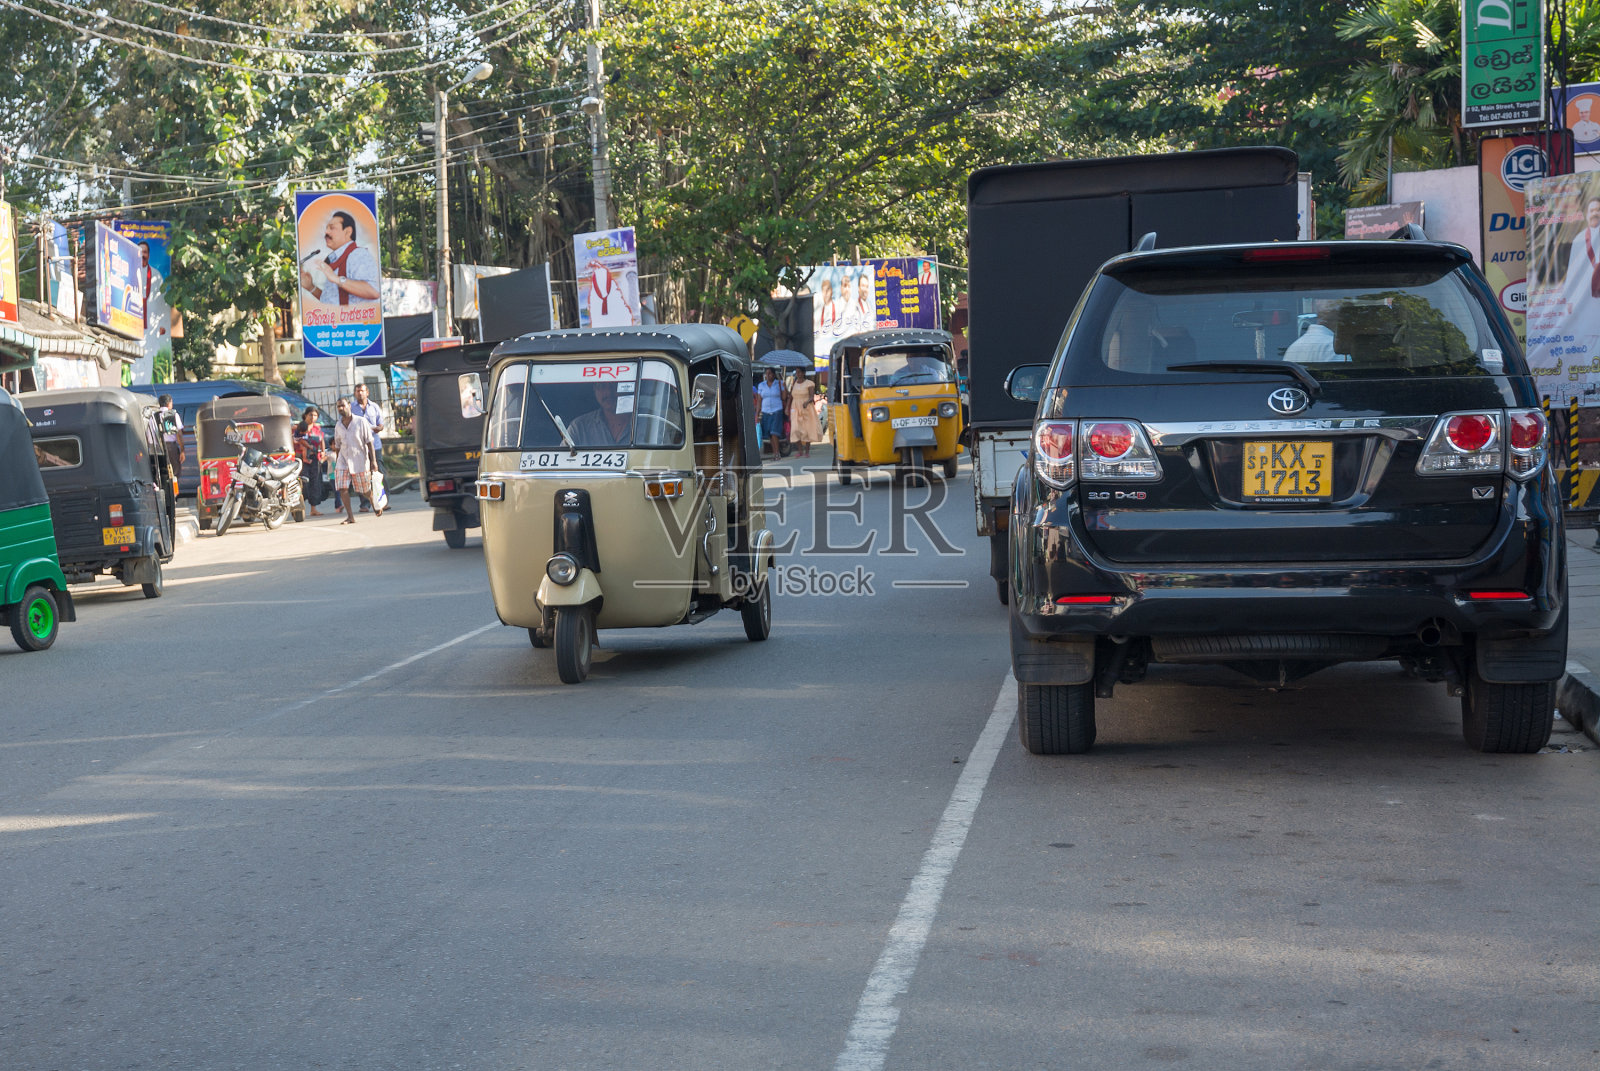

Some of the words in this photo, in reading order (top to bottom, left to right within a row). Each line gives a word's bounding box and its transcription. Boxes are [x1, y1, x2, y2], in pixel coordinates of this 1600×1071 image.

[1471, 72, 1536, 99] ලයින්
[1512, 154, 1540, 173] ICI
[582, 365, 630, 379] BRP
[538, 453, 560, 469] QI
[580, 453, 626, 467] 1243
[1272, 444, 1306, 469] KX
[1254, 470, 1321, 494] 1713
